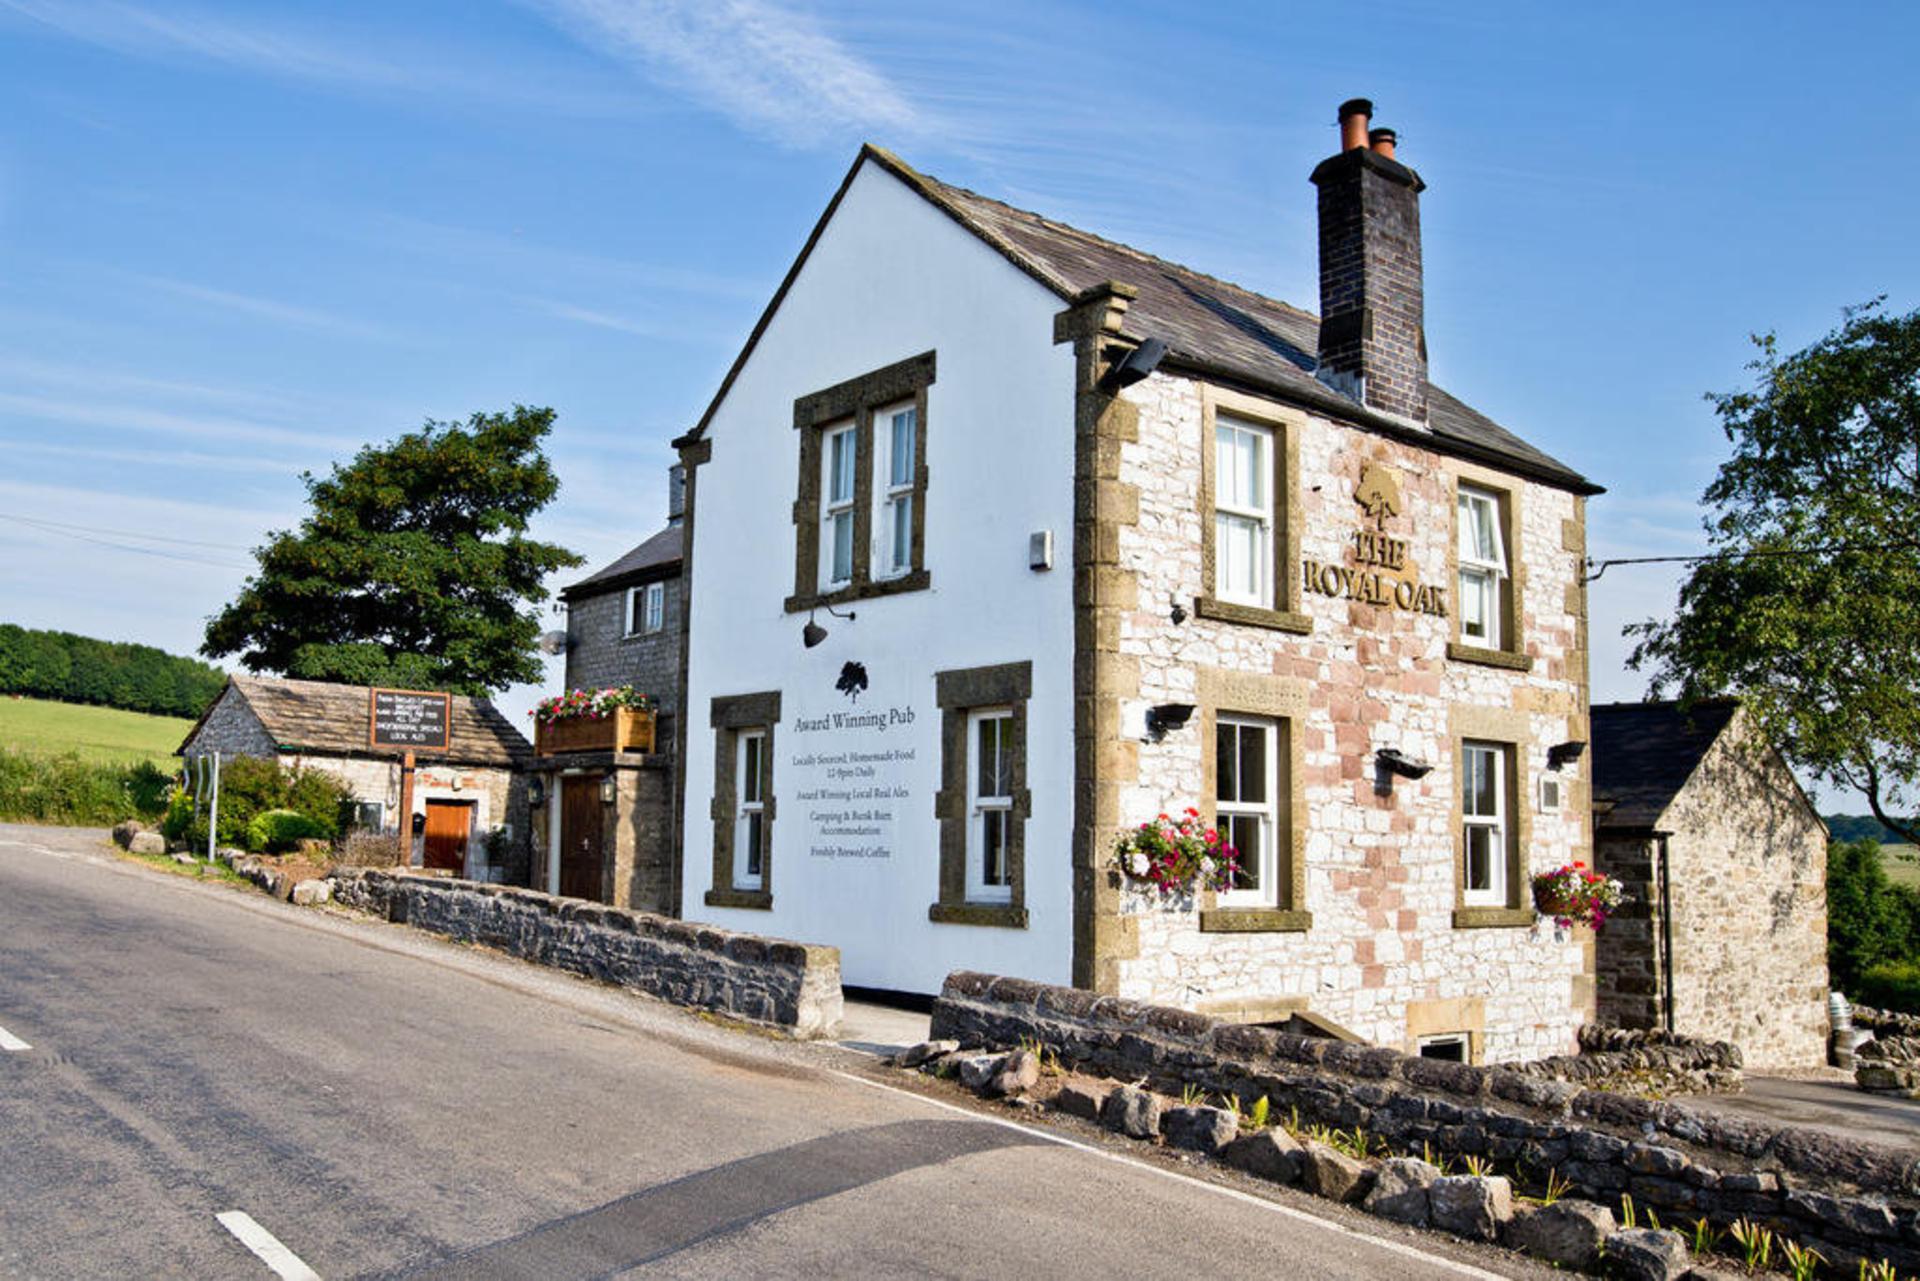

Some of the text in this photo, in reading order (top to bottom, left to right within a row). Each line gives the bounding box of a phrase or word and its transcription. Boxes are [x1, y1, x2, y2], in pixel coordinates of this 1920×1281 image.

[1355, 530, 1405, 570] THE
[1303, 560, 1449, 618] ROYAL OAK
[794, 705, 916, 733] Award Winning Pub
[849, 750, 893, 762] Homemade
[894, 747, 916, 760] Food
[854, 766, 876, 779] Daily
[796, 785, 909, 802] Award Winning Local Real Ales
[809, 810, 842, 825] Camping
[851, 810, 872, 821] Bunk
[874, 809, 892, 821] Barn
[865, 846, 891, 858] Coffee
